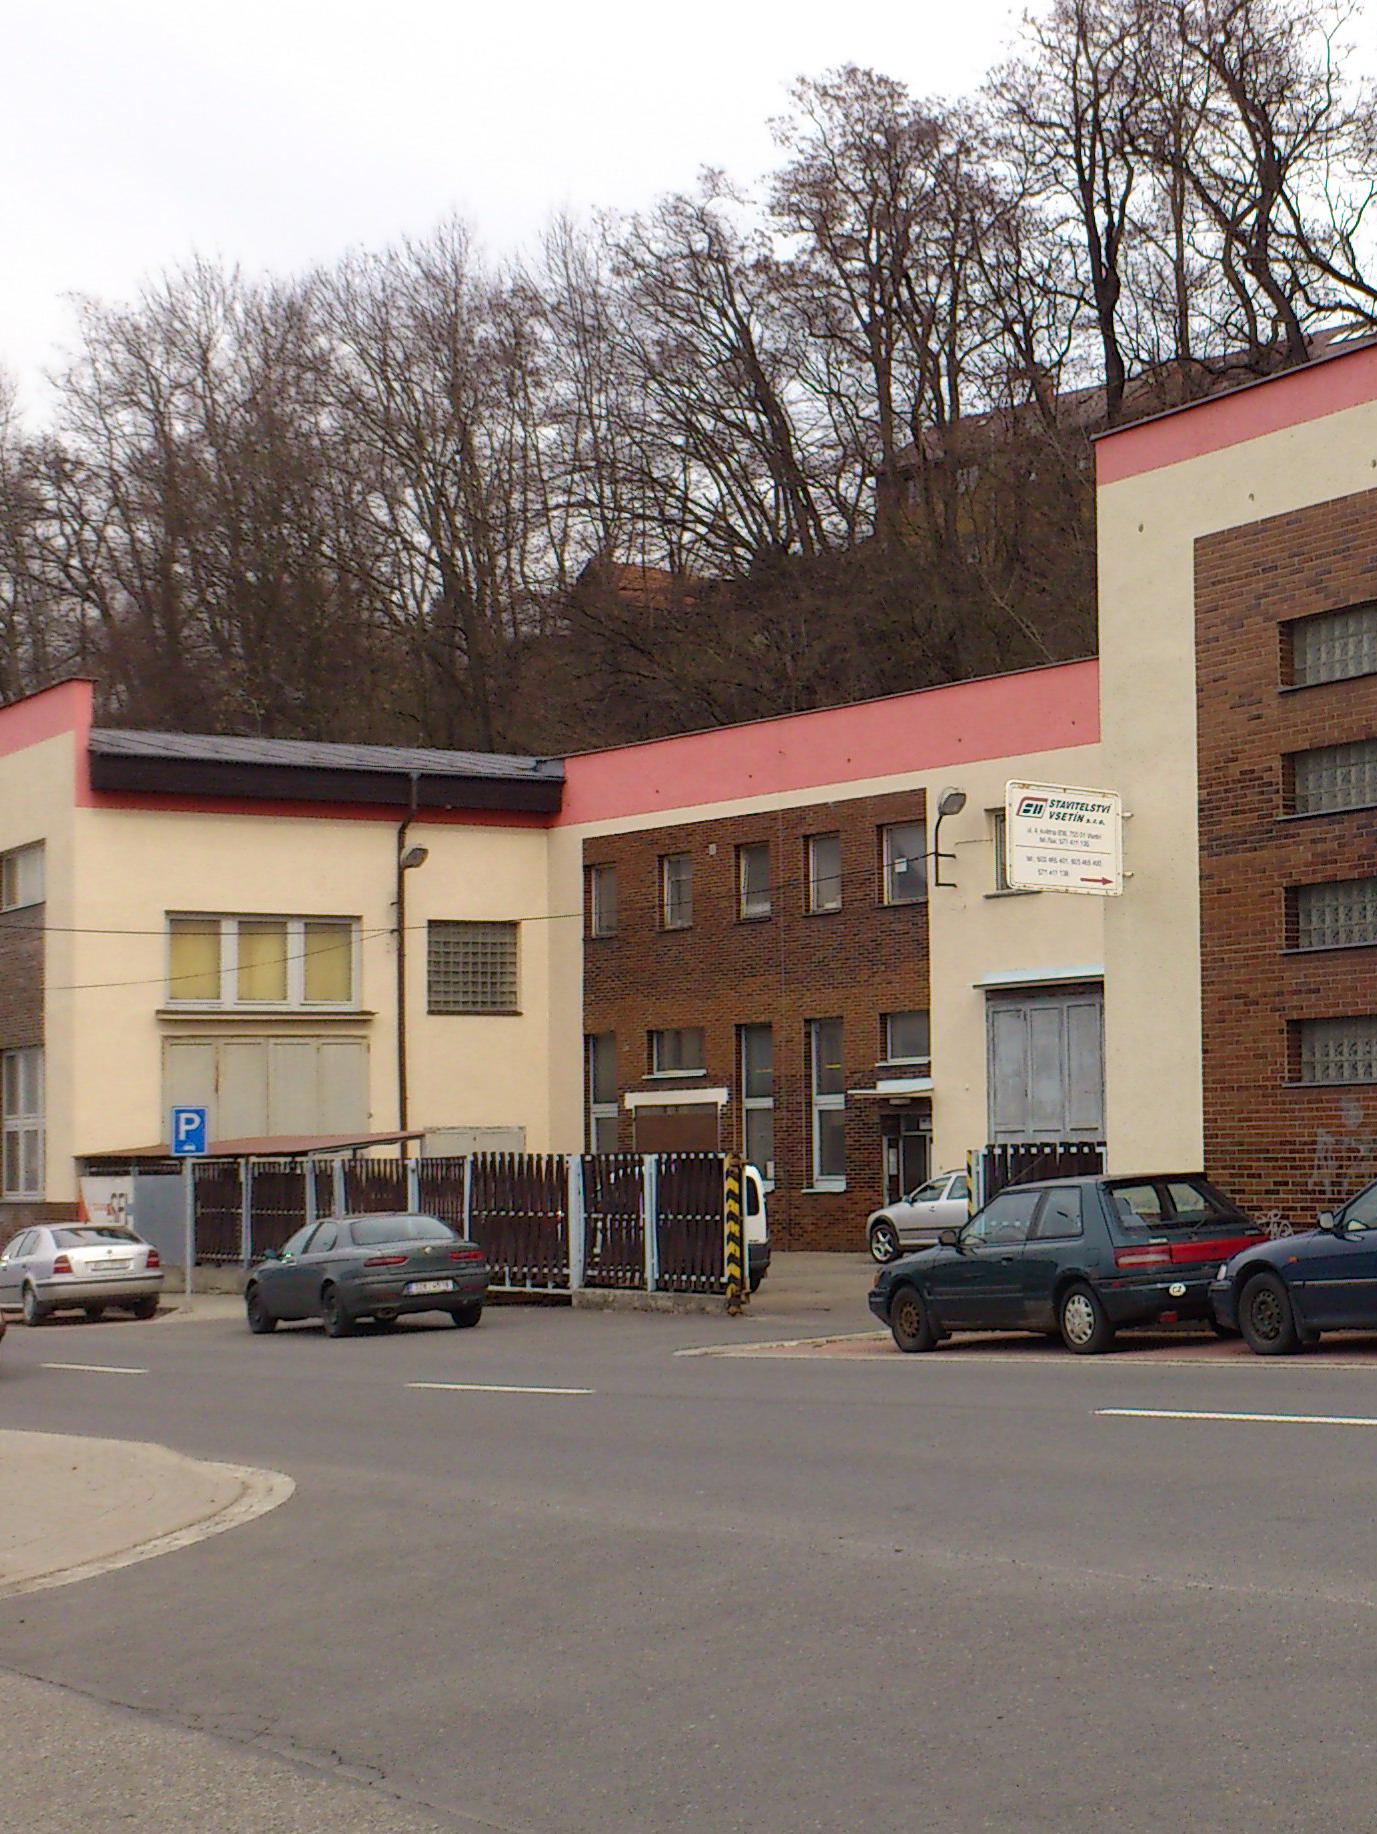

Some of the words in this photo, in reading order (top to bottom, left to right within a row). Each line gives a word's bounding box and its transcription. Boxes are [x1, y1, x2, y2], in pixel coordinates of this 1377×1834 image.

[1049, 799, 1112, 814] STAVITELSTVÍ
[1049, 811, 1085, 823] VSETÍN
[179, 1112, 201, 1141] P
